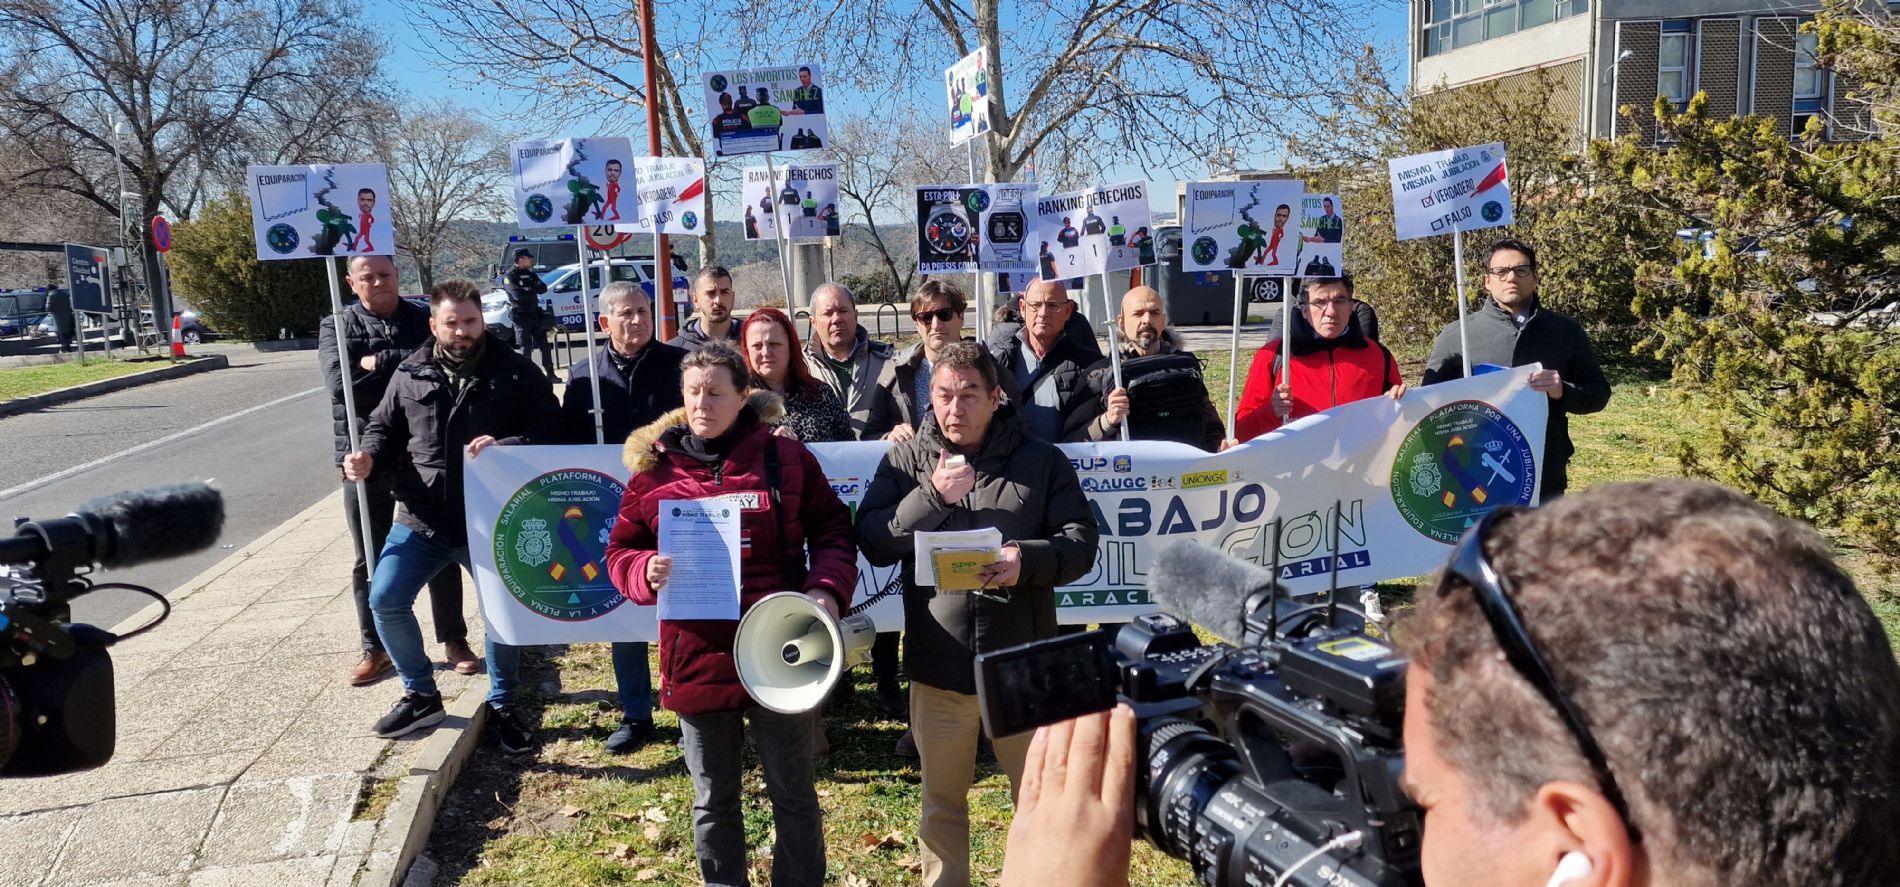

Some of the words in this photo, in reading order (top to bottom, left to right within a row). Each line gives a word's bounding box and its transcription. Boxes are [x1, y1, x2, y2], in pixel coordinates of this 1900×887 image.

[732, 72, 748, 85] LOS
[750, 68, 798, 83] FAVORITOS
[1397, 164, 1432, 181] MISMO
[1435, 152, 1470, 170] TRABAJO
[748, 171, 784, 183] RANKNG
[786, 168, 834, 181] DERECHOS
[1401, 173, 1437, 192] MISMA
[642, 186, 677, 204] VERDADERO
[1434, 177, 1475, 203] VERDADERO
[1038, 195, 1085, 217] RANKING
[1086, 185, 1142, 208] DERECHOS
[768, 218, 774, 229] 2
[787, 212, 792, 225] 1
[808, 220, 814, 228] 3
[1444, 205, 1472, 227] FALSO
[592, 225, 615, 237] 20
[1092, 243, 1098, 258] 1
[1117, 249, 1123, 258] 3
[1068, 254, 1075, 266] 2
[1019, 273, 1025, 283] 2
[562, 315, 582, 325] 900
[1429, 403, 1480, 423] PLATAFORMA
[1484, 407, 1502, 422] POR
[1506, 423, 1522, 443] UNA
[1396, 426, 1423, 464] SALARIAL
[1069, 457, 1108, 471] SUP
[539, 471, 603, 487] PLATAFORMA
[1100, 476, 1146, 491] AUGC
[502, 488, 533, 527] SALARIAL
[1088, 484, 1265, 537] ABAJO
[1281, 553, 1365, 578] ARIAL
[530, 599, 561, 617] PLENA
[603, 593, 624, 610] GNA
[569, 610, 582, 618] LA
